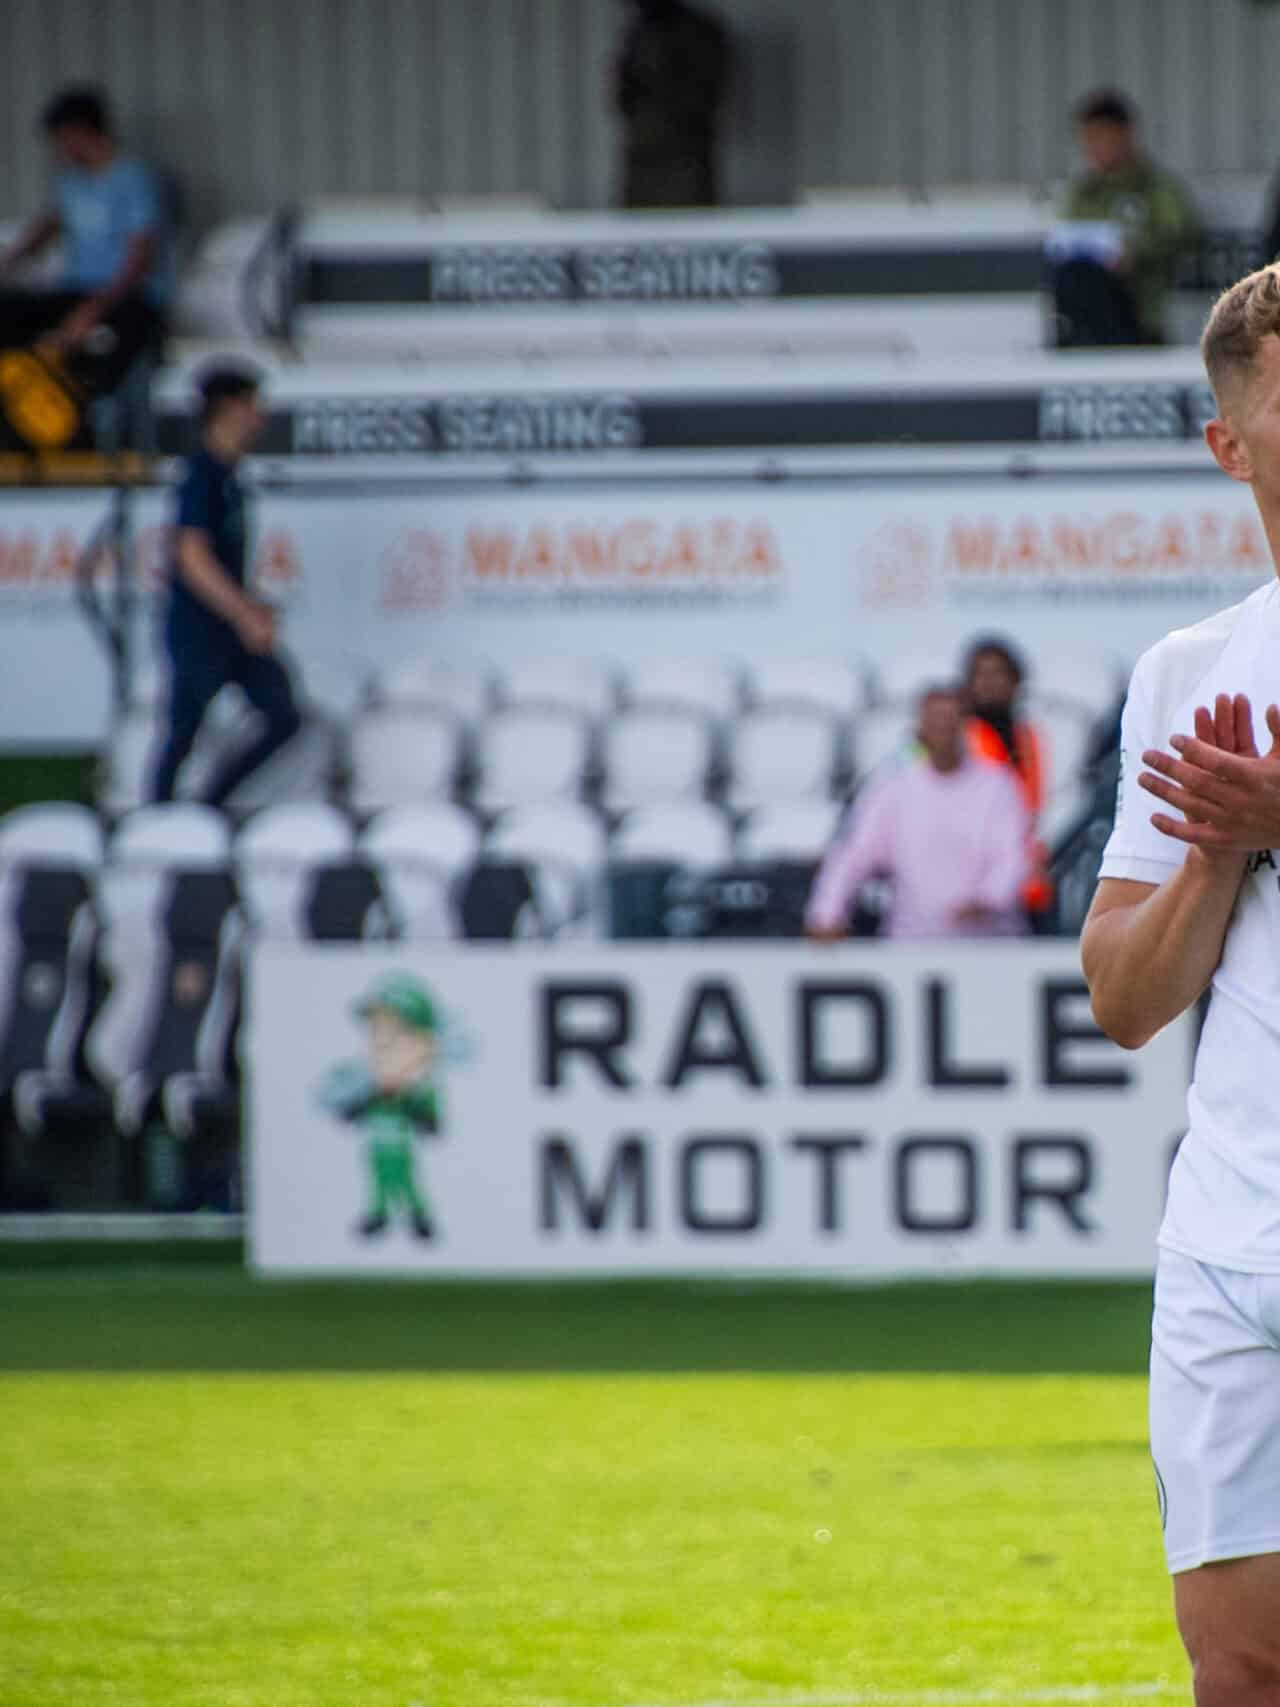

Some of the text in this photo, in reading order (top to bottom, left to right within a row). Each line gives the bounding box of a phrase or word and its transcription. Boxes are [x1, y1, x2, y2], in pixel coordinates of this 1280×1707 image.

[432, 247, 774, 298] PRESS SEATING
[296, 397, 638, 452] PRESS SEATING
[1041, 384, 1179, 438] PRESS
[466, 518, 780, 577] MANGATA
[948, 514, 1267, 571] MANGATA
[537, 978, 1133, 1088] RADLE
[539, 1135, 1098, 1232] MOTOR
